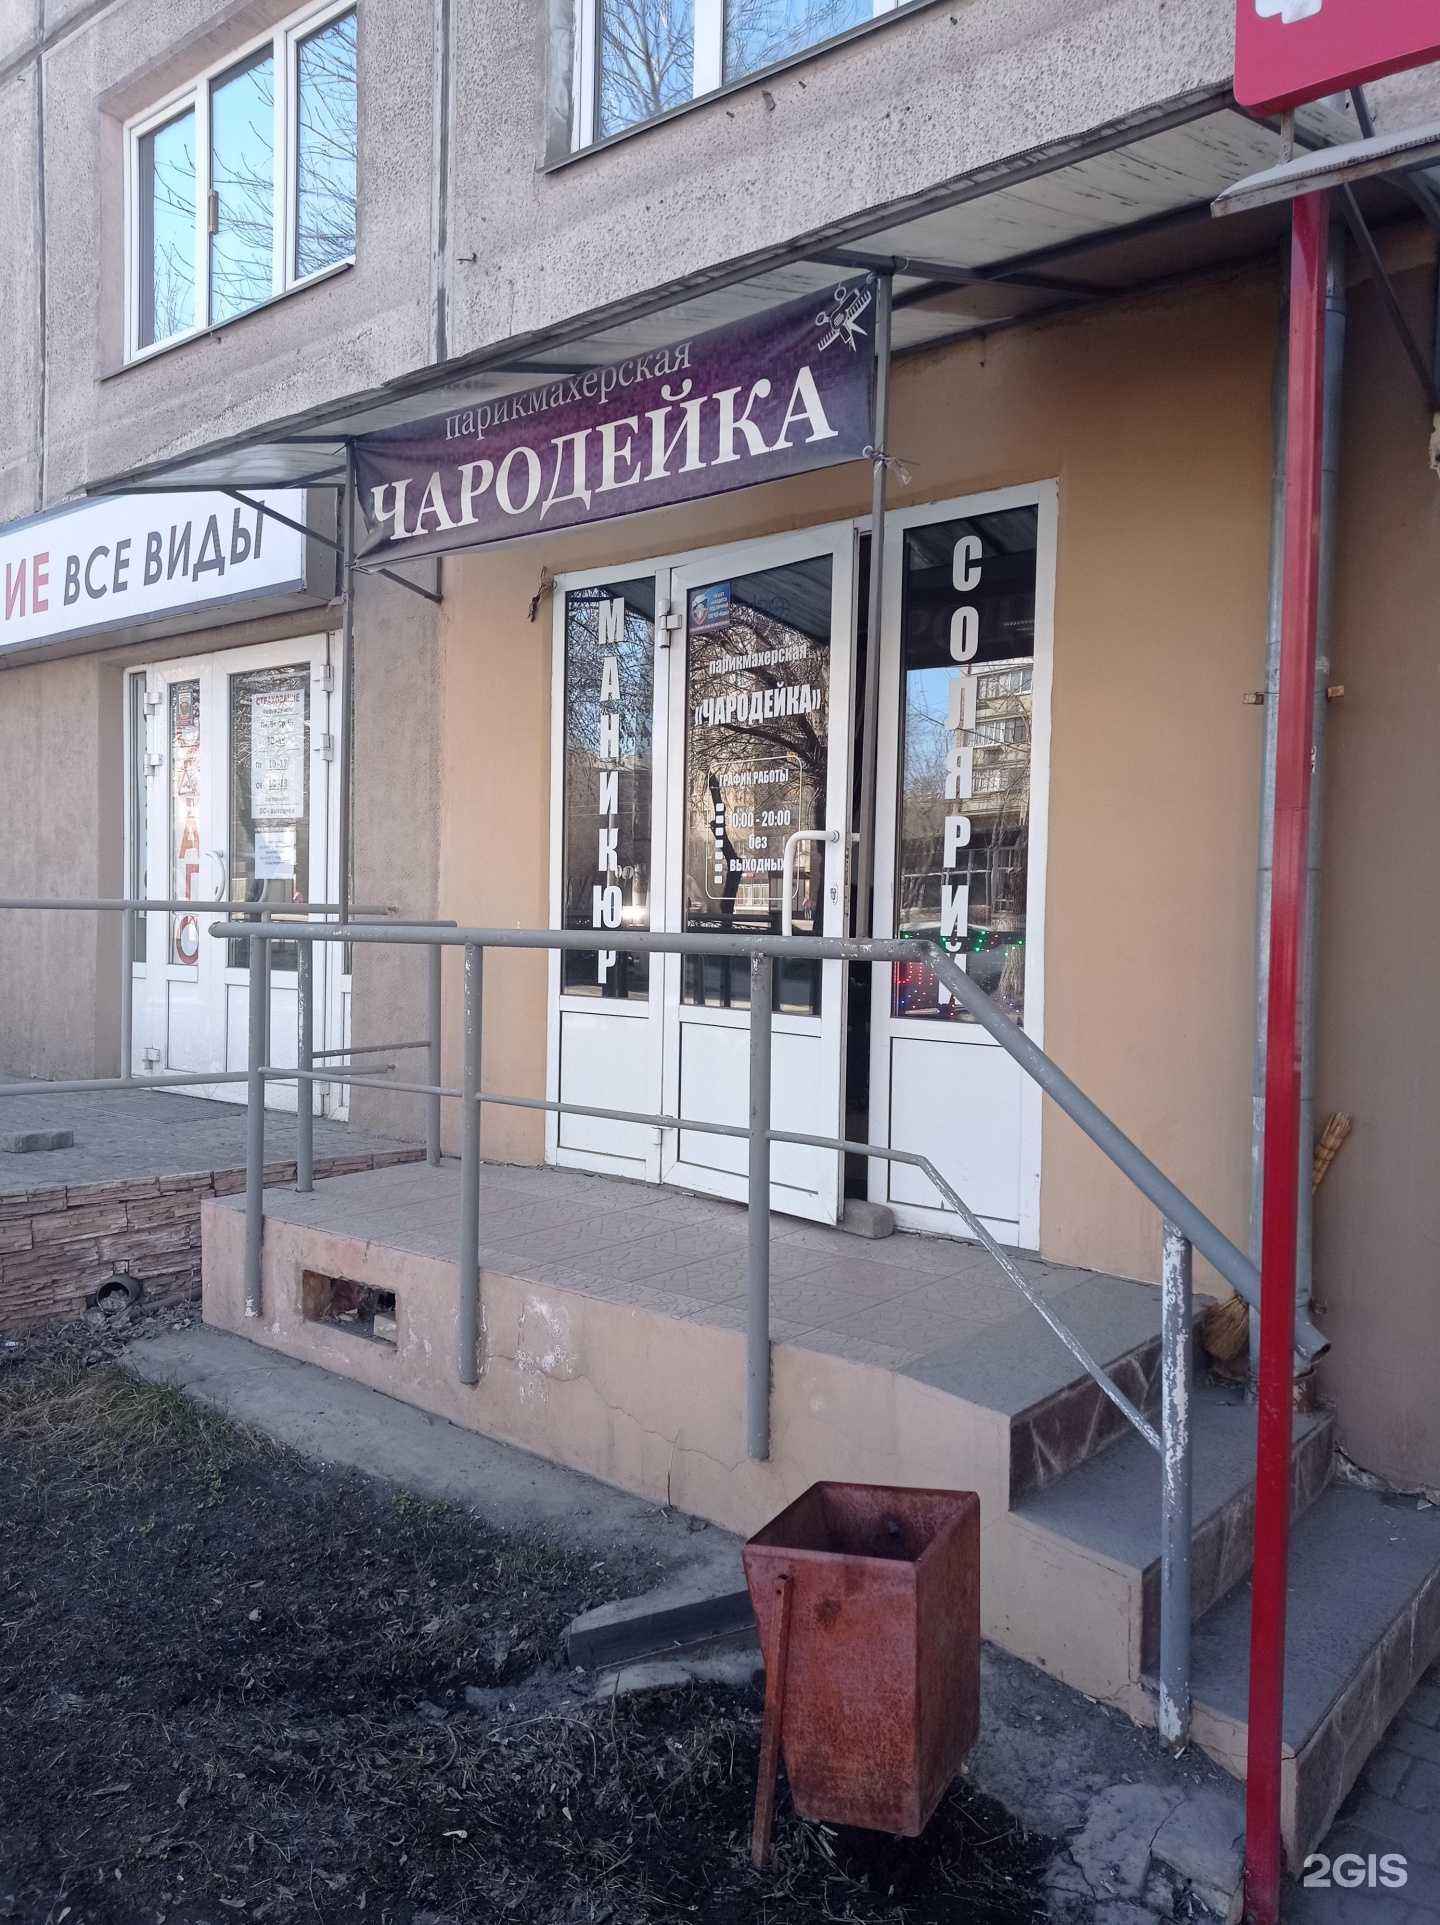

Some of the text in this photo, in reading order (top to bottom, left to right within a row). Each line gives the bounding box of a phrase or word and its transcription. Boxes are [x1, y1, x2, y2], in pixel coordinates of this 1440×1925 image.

[444, 341, 693, 441] парикмахерская
[370, 365, 839, 541] ЧАРОДЕЙКА
[63, 537, 132, 607] ВСЕ
[143, 499, 266, 587] ВИДЫ
[592, 597, 625, 985] МАНИКЮР
[753, 769, 789, 785] РАБОТЫ
[761, 810, 791, 827] 20:00
[748, 833, 768, 850] без
